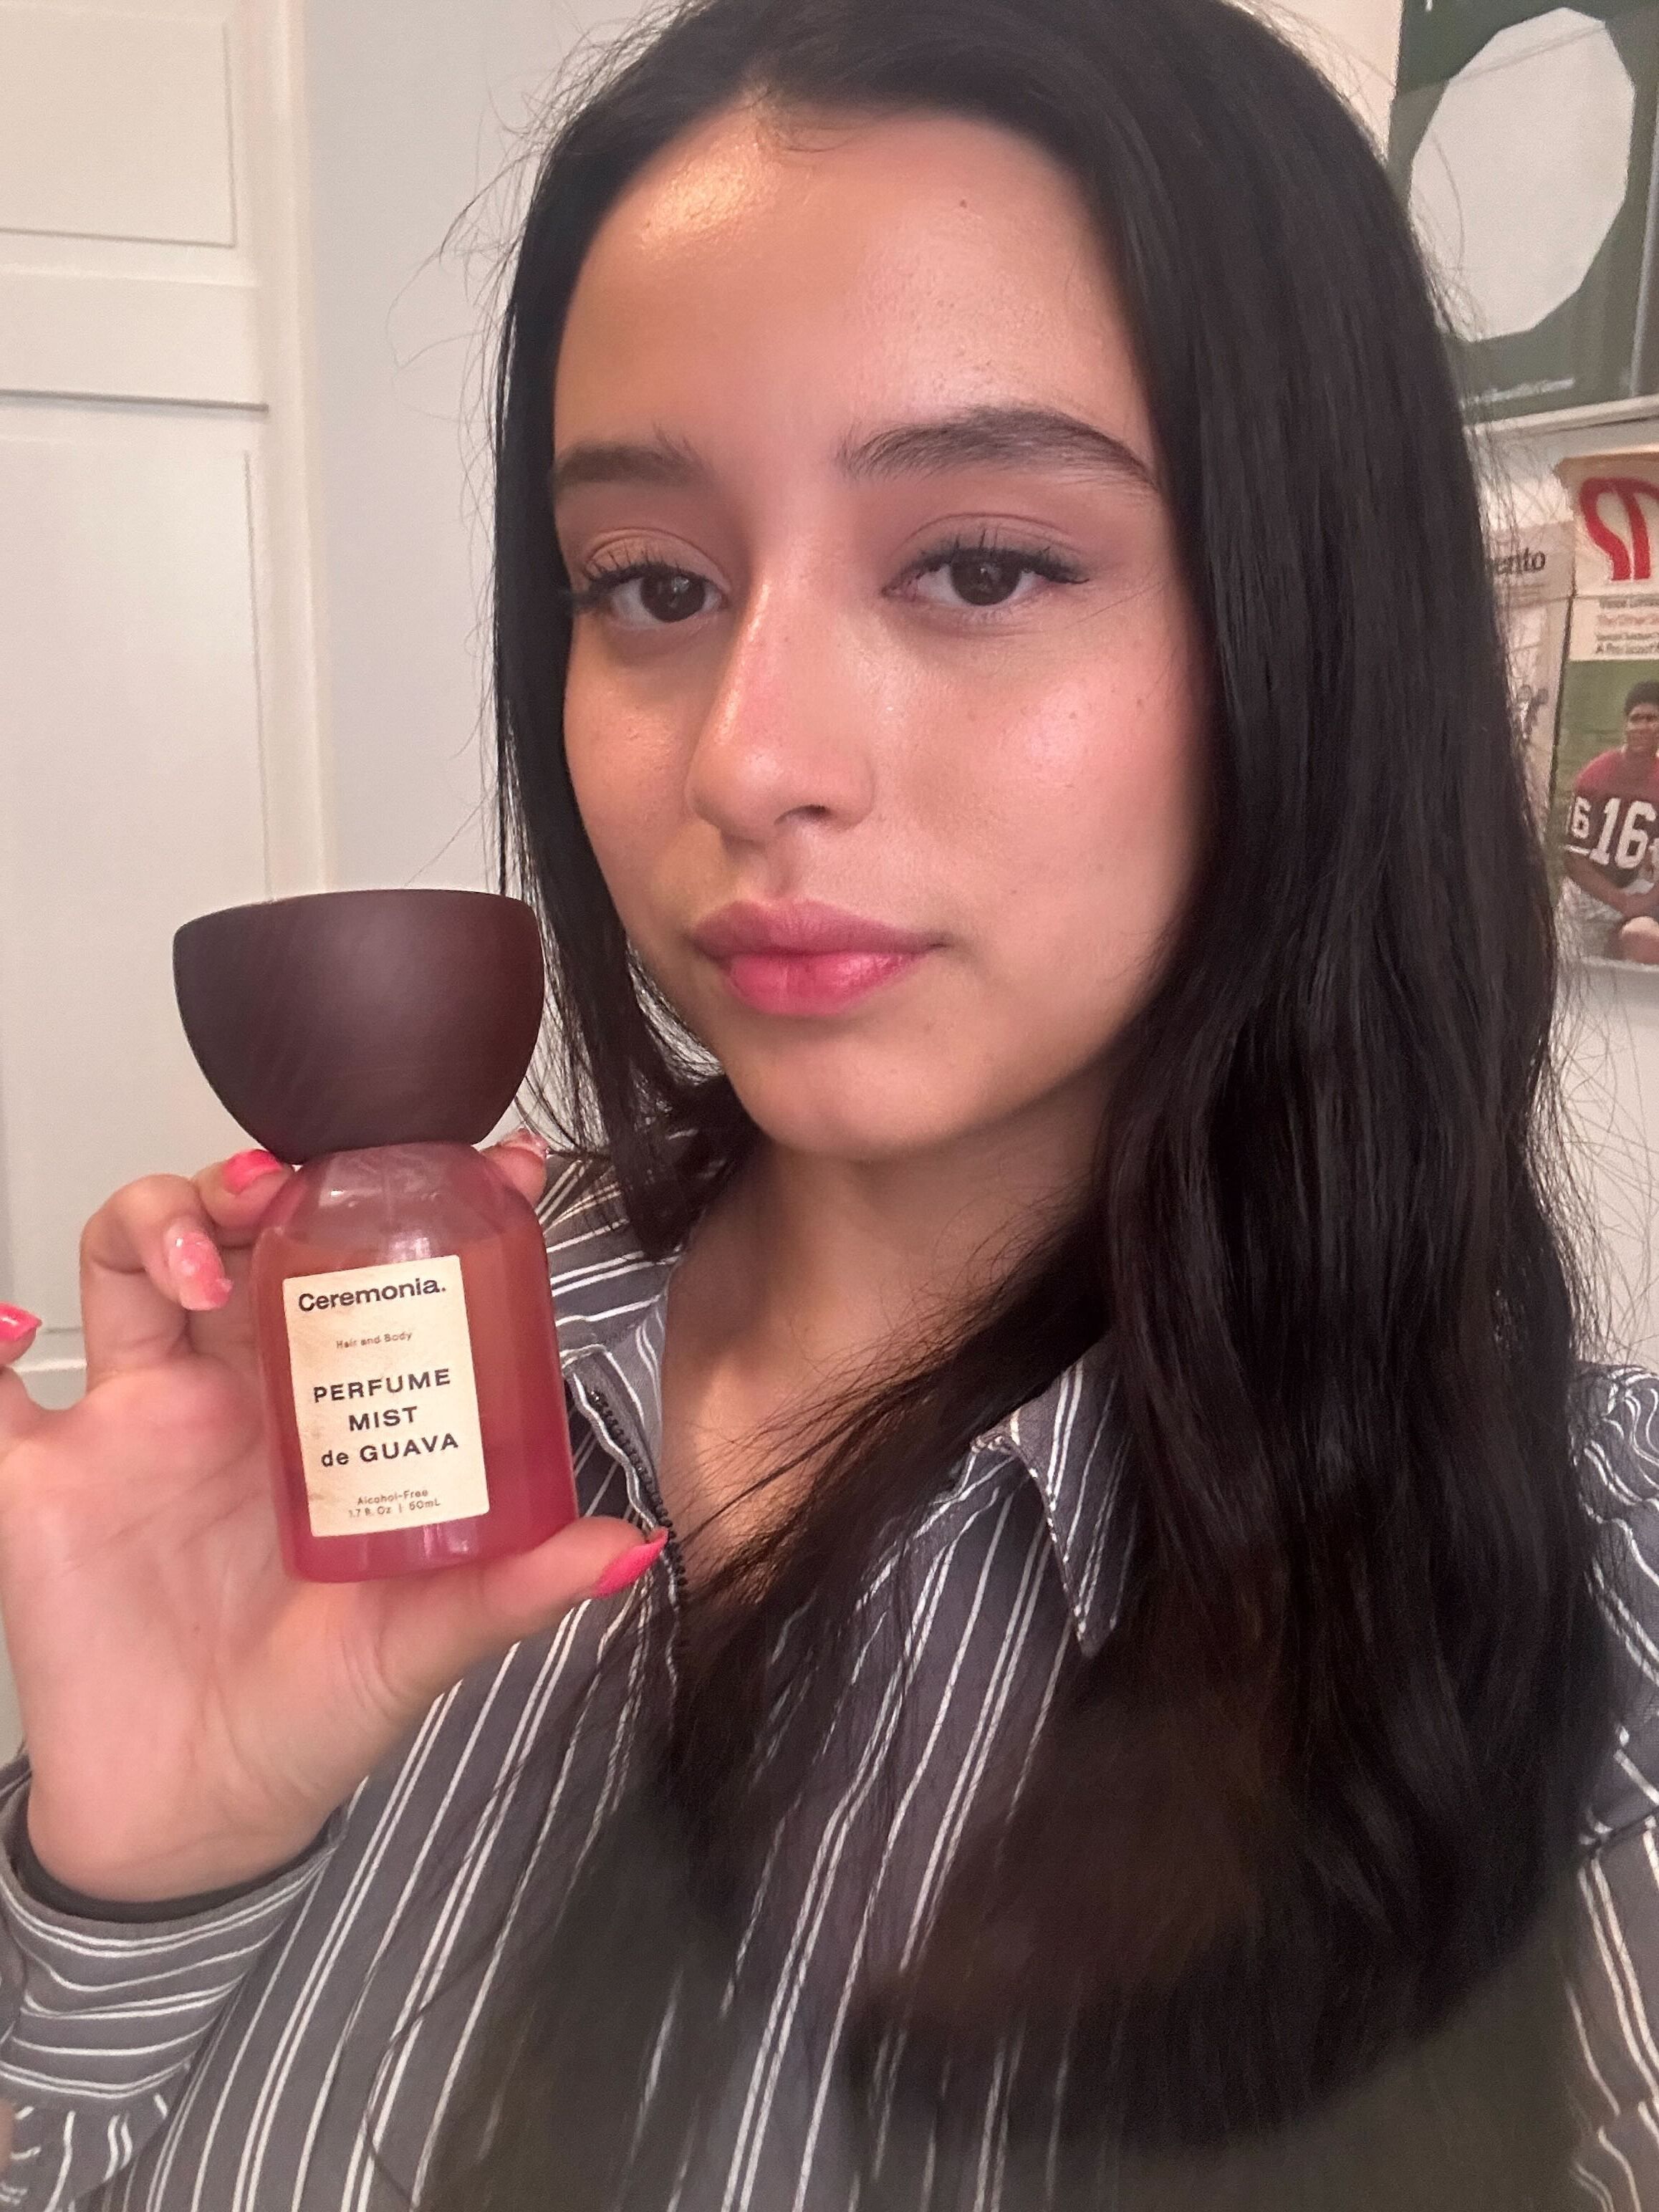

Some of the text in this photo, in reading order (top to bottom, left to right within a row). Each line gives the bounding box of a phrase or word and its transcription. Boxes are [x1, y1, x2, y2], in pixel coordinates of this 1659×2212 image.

[1589, 797, 1656, 868] 16
[299, 1277, 446, 1312] Ceremonia.
[336, 1331, 413, 1350] Hair and Body
[313, 1367, 451, 1403] PERFUME
[349, 1405, 418, 1432] MIST
[321, 1433, 459, 1468] de GUAVA
[357, 1489, 429, 1506] Alcohol-Free
[377, 1506, 392, 1515] Oz
[409, 1497, 441, 1511] 50mL
